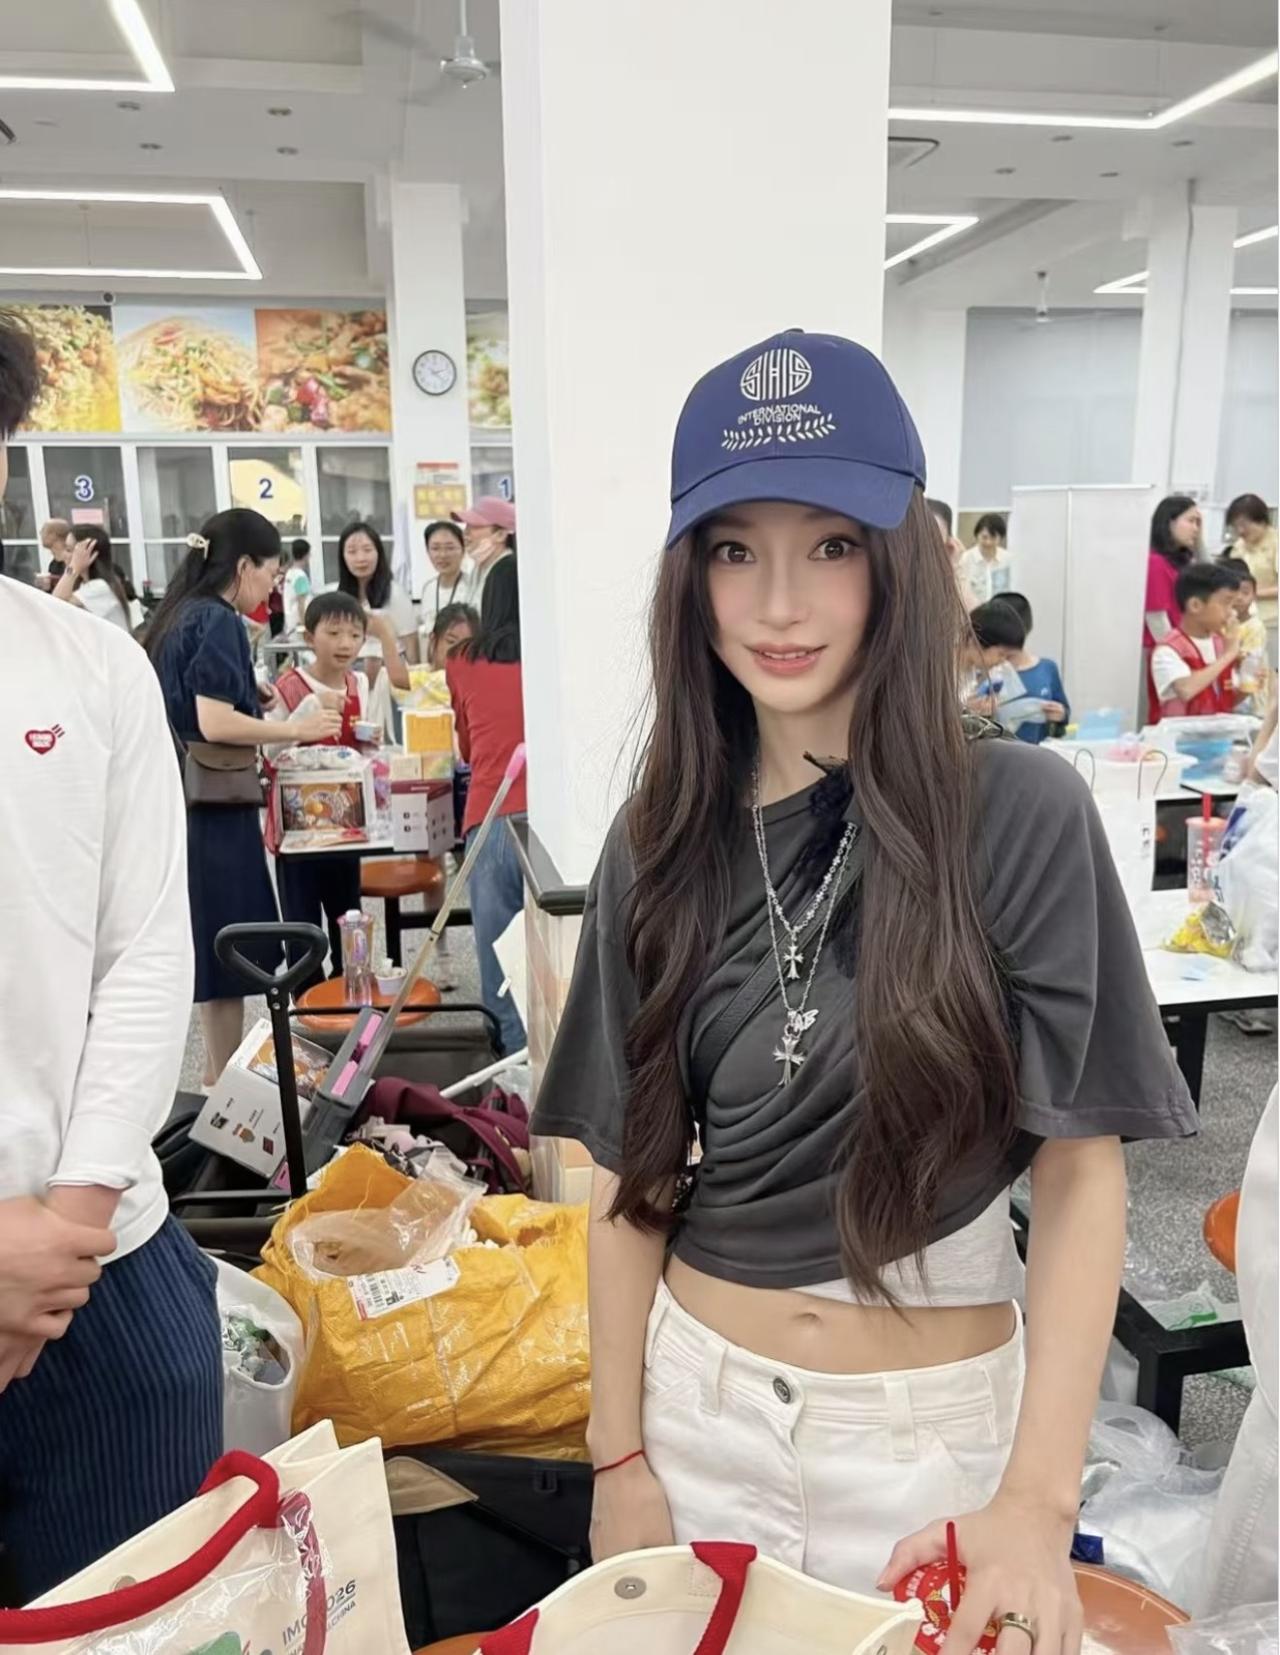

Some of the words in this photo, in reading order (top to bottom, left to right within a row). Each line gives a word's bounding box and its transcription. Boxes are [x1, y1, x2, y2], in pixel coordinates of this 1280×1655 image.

[738, 404, 821, 424] INTERNATIONAL
[754, 412, 801, 426] DIVISION
[75, 476, 93, 500] 3
[258, 478, 273, 499] 2
[501, 478, 511, 499] 1
[326, 1579, 356, 1611] 026
